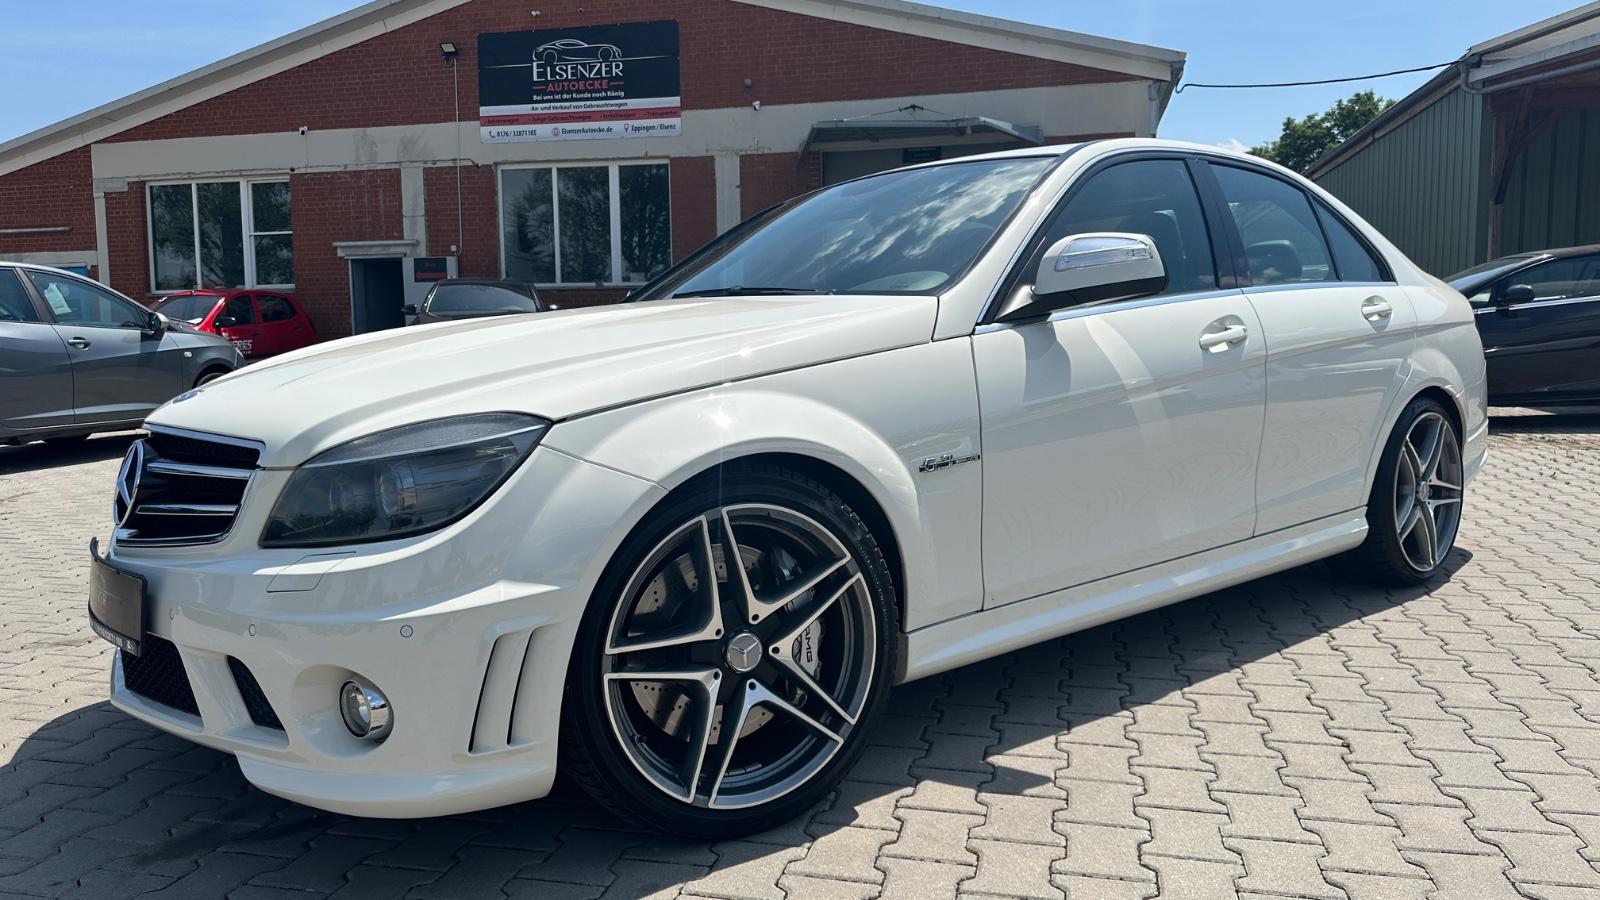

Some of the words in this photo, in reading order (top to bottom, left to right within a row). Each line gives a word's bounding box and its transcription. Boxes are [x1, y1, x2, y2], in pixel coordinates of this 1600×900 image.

[532, 62, 624, 81] ELSENZER
[546, 80, 609, 91] AUTOECKE
[631, 124, 656, 132] Eppingen
